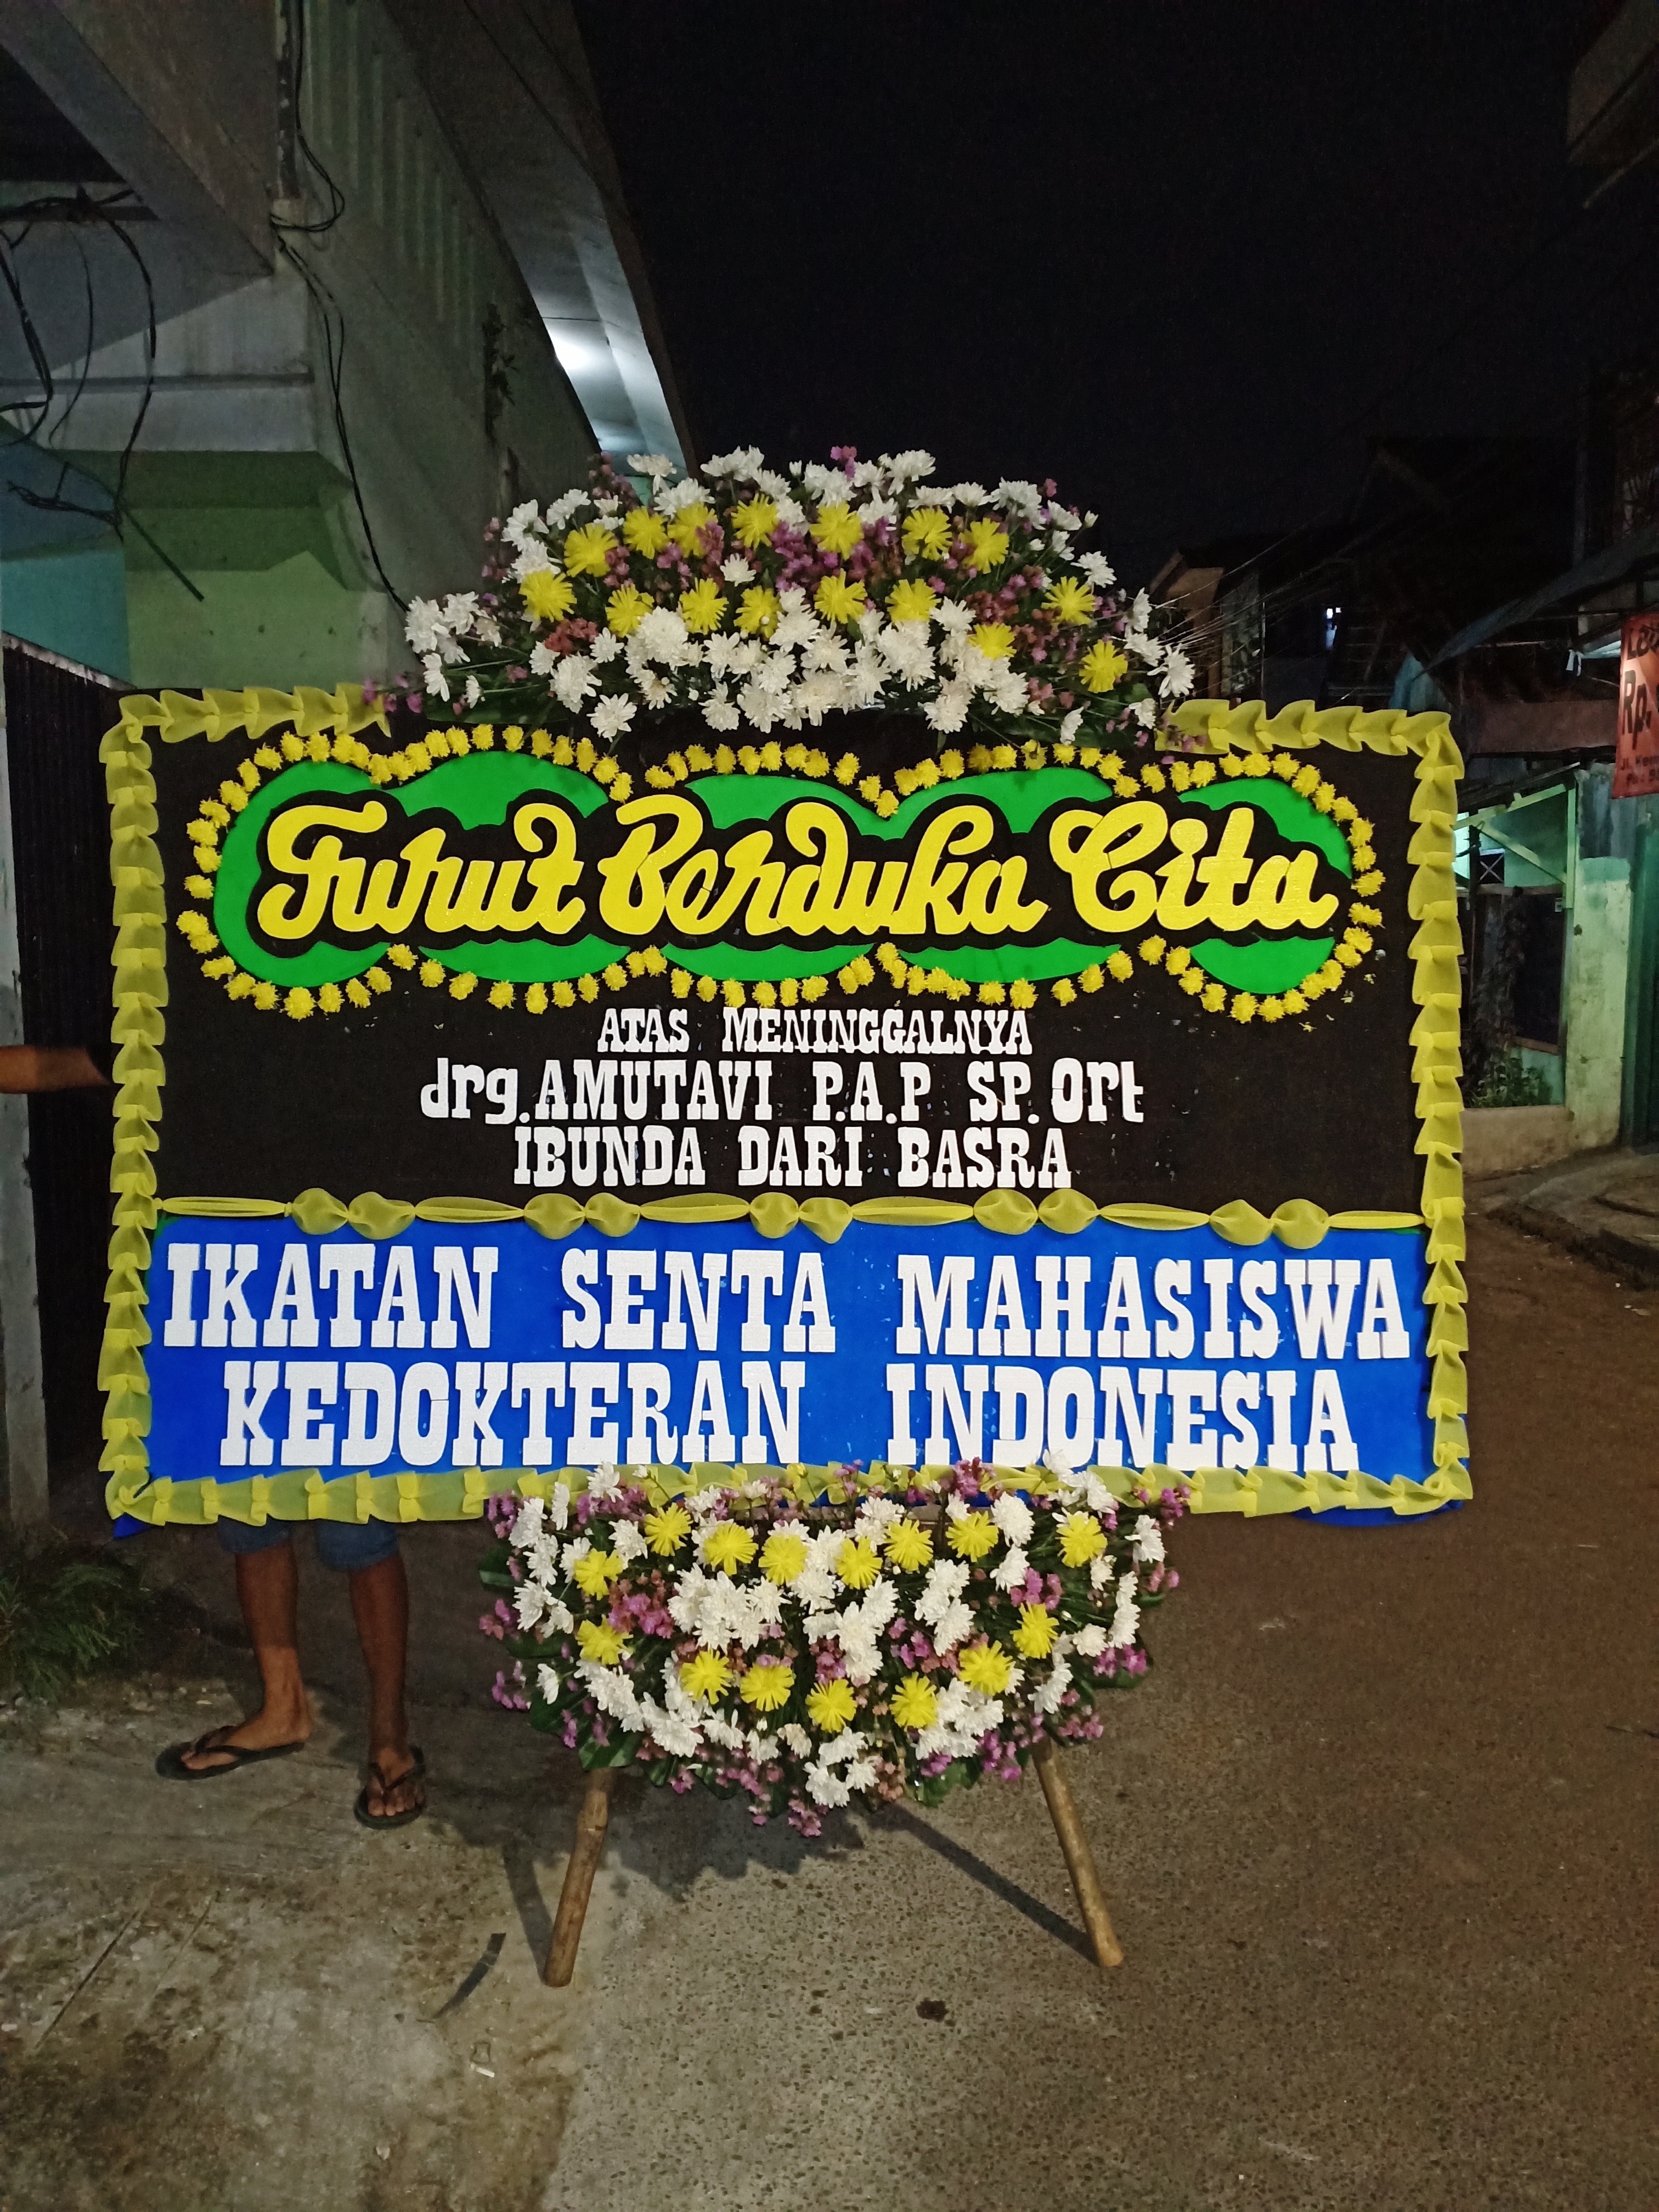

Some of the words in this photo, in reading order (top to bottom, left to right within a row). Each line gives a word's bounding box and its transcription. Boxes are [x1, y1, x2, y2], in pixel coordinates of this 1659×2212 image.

[257, 800, 585, 939] Turut
[597, 793, 1051, 936] Berduka
[1049, 800, 1340, 933] Cita
[596, 1007, 690, 1053] ATAS
[721, 1006, 1032, 1056] MENINGGALNYA
[812, 1060, 932, 1124] P.A.P
[513, 1125, 706, 1187] IBUNDA
[737, 1125, 864, 1187] DARI
[898, 1126, 1073, 1189] BASRA
[163, 1243, 499, 1348] IKATAN
[561, 1248, 836, 1353] SENTA
[896, 1254, 1410, 1360] MAHASISWA
[220, 1361, 806, 1466] KEDOKTERAN
[886, 1363, 1360, 1471] INDONESIA
